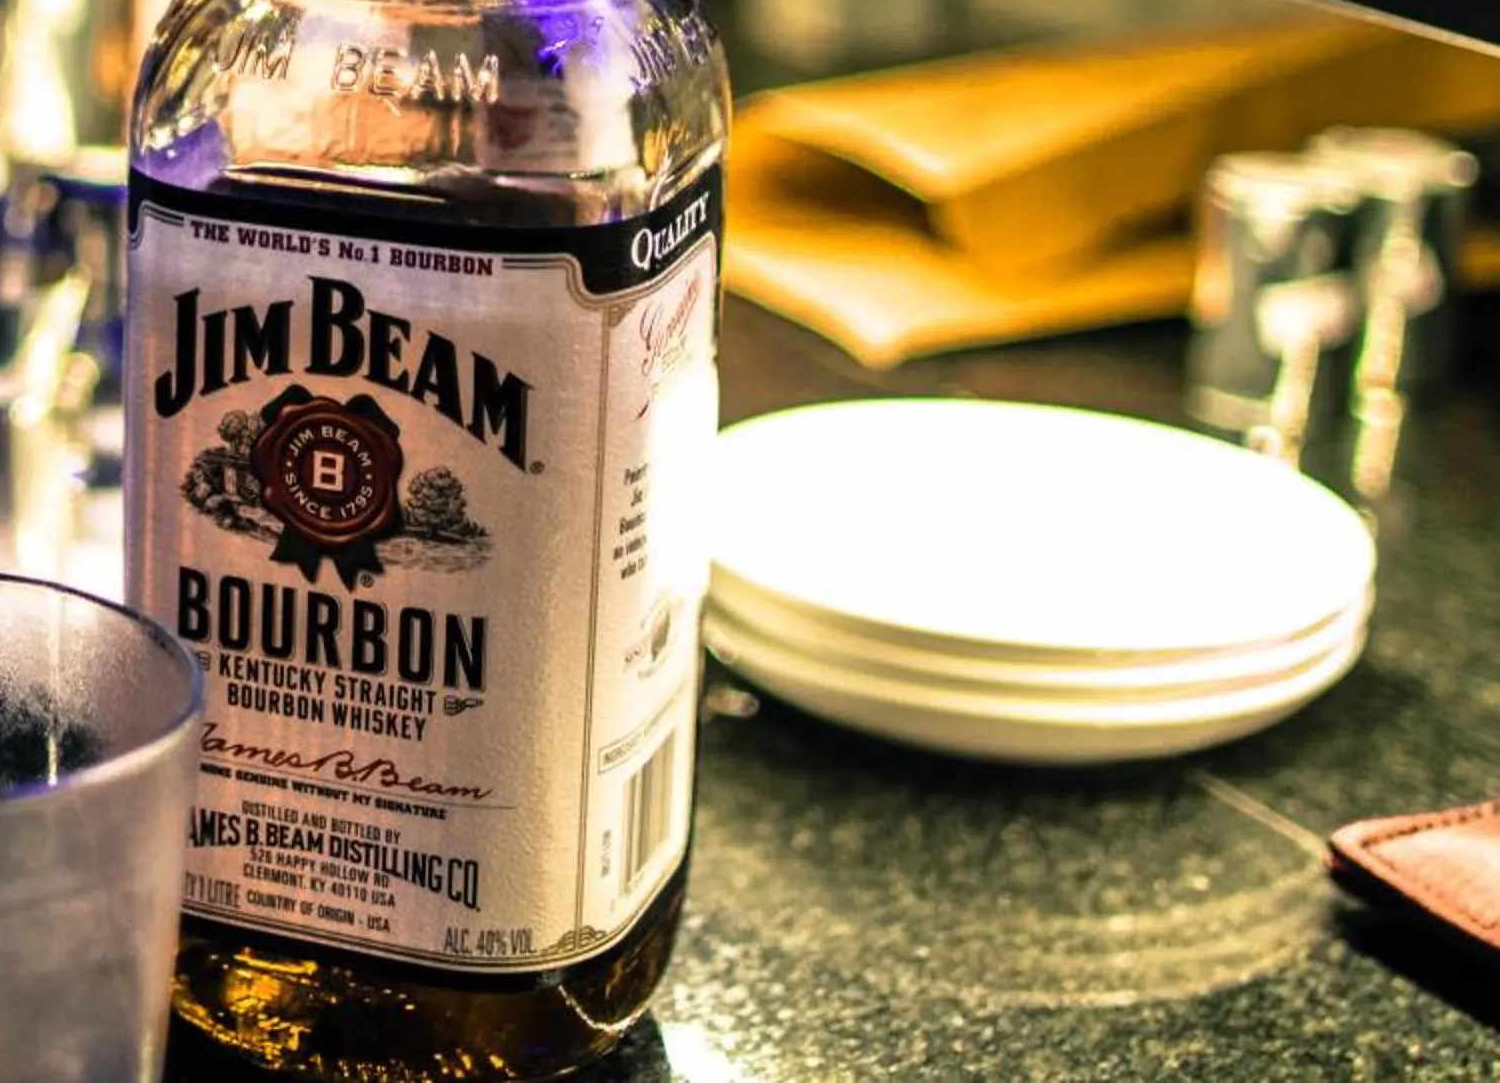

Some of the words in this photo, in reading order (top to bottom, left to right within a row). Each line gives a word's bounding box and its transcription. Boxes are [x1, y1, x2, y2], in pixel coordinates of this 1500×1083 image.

[332, 43, 499, 104] BEAM
[190, 219, 230, 243] THE
[237, 226, 331, 257] WORLD'S
[389, 247, 494, 277] BOURBON
[630, 191, 710, 271] QUALITY
[153, 287, 295, 419] JIM
[303, 274, 534, 473] BEAM
[288, 428, 315, 458] JIM
[320, 424, 373, 468] BEAM
[311, 450, 346, 493] B
[284, 472, 333, 519] SINCE
[339, 485, 374, 518] 1795
[177, 566, 488, 693] BOURBON
[218, 652, 327, 695] KENTUCKY
[333, 674, 438, 716] STRAIGHT
[227, 682, 326, 723] BOURBON
[331, 702, 428, 743] WHISKEY
[241, 799, 299, 824] DISTILLED
[301, 812, 327, 831] AND
[331, 817, 381, 840] BOTTLED
[385, 828, 402, 844] BY
[291, 779, 350, 804] WITHOUT
[352, 793, 372, 808] MY
[374, 798, 449, 821] SIGNATURE
[187, 805, 241, 848] AMES
[329, 835, 443, 894] DISTILLING
[250, 847, 273, 864] 526
[276, 852, 317, 874] HAPPY
[319, 860, 370, 885] HOLLOW
[207, 877, 241, 909] LITRE
[246, 889, 297, 913] COUNTRY
[299, 900, 314, 916] OF
[317, 904, 355, 926] ORIGIN
[366, 914, 392, 934] USA
[310, 877, 327, 893] KY
[331, 881, 367, 902] 40110
[371, 889, 396, 908] USA
[476, 927, 508, 956] 40%
